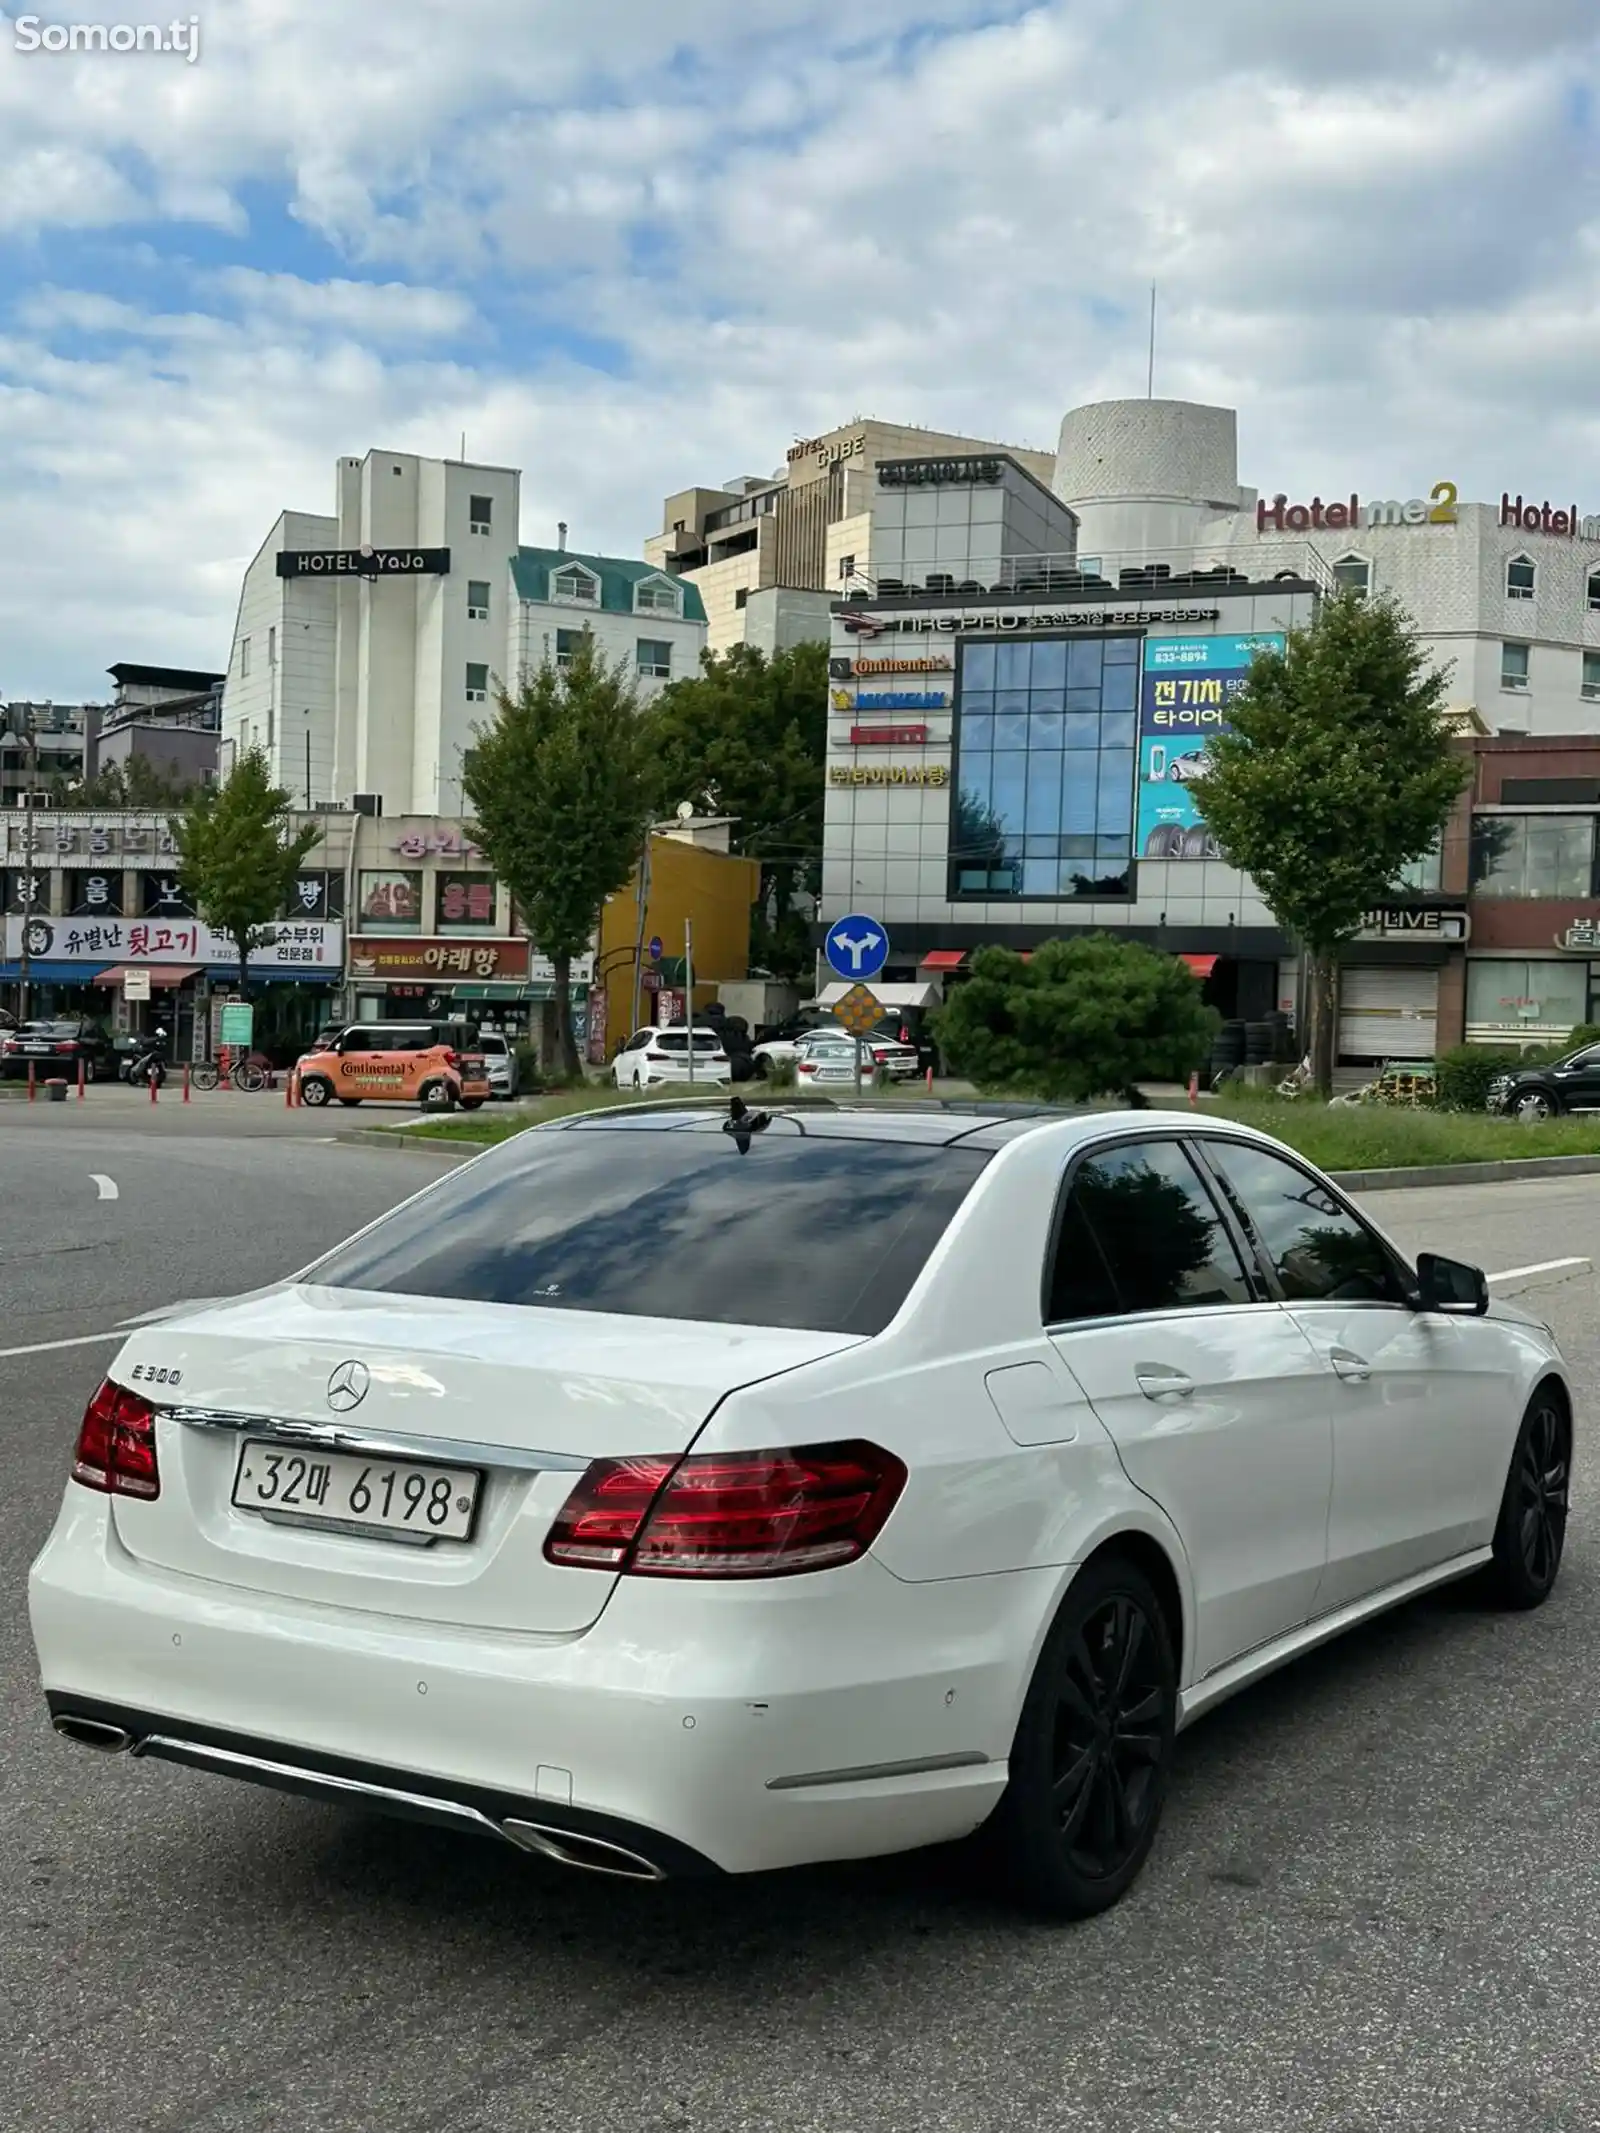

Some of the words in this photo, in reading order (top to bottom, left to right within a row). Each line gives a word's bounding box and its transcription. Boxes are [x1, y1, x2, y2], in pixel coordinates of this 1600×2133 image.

[787, 438, 825, 462] HOTEL
[816, 433, 865, 469] CUBE
[1257, 493, 1358, 532] Hotel
[1367, 482, 1458, 525] me2
[1501, 492, 1577, 537] Hotel
[298, 555, 358, 571] HOTEL
[898, 615, 954, 632] TIRE
[960, 614, 1019, 630] PRO
[1112, 609, 1214, 623] 833-8894
[853, 656, 936, 675] Continental
[1155, 652, 1208, 664] 833-8894
[1154, 678, 1223, 706] 전기차
[1153, 708, 1222, 728] 타이어
[64, 923, 122, 954] 유별난
[127, 924, 197, 957] 뒷고기
[276, 926, 324, 944] 수부위
[277, 947, 313, 961] 전문점
[423, 946, 498, 976] 야래향
[340, 1060, 406, 1077] Continental
[257, 1454, 331, 1505] 32마
[350, 1466, 452, 1526] 6198
